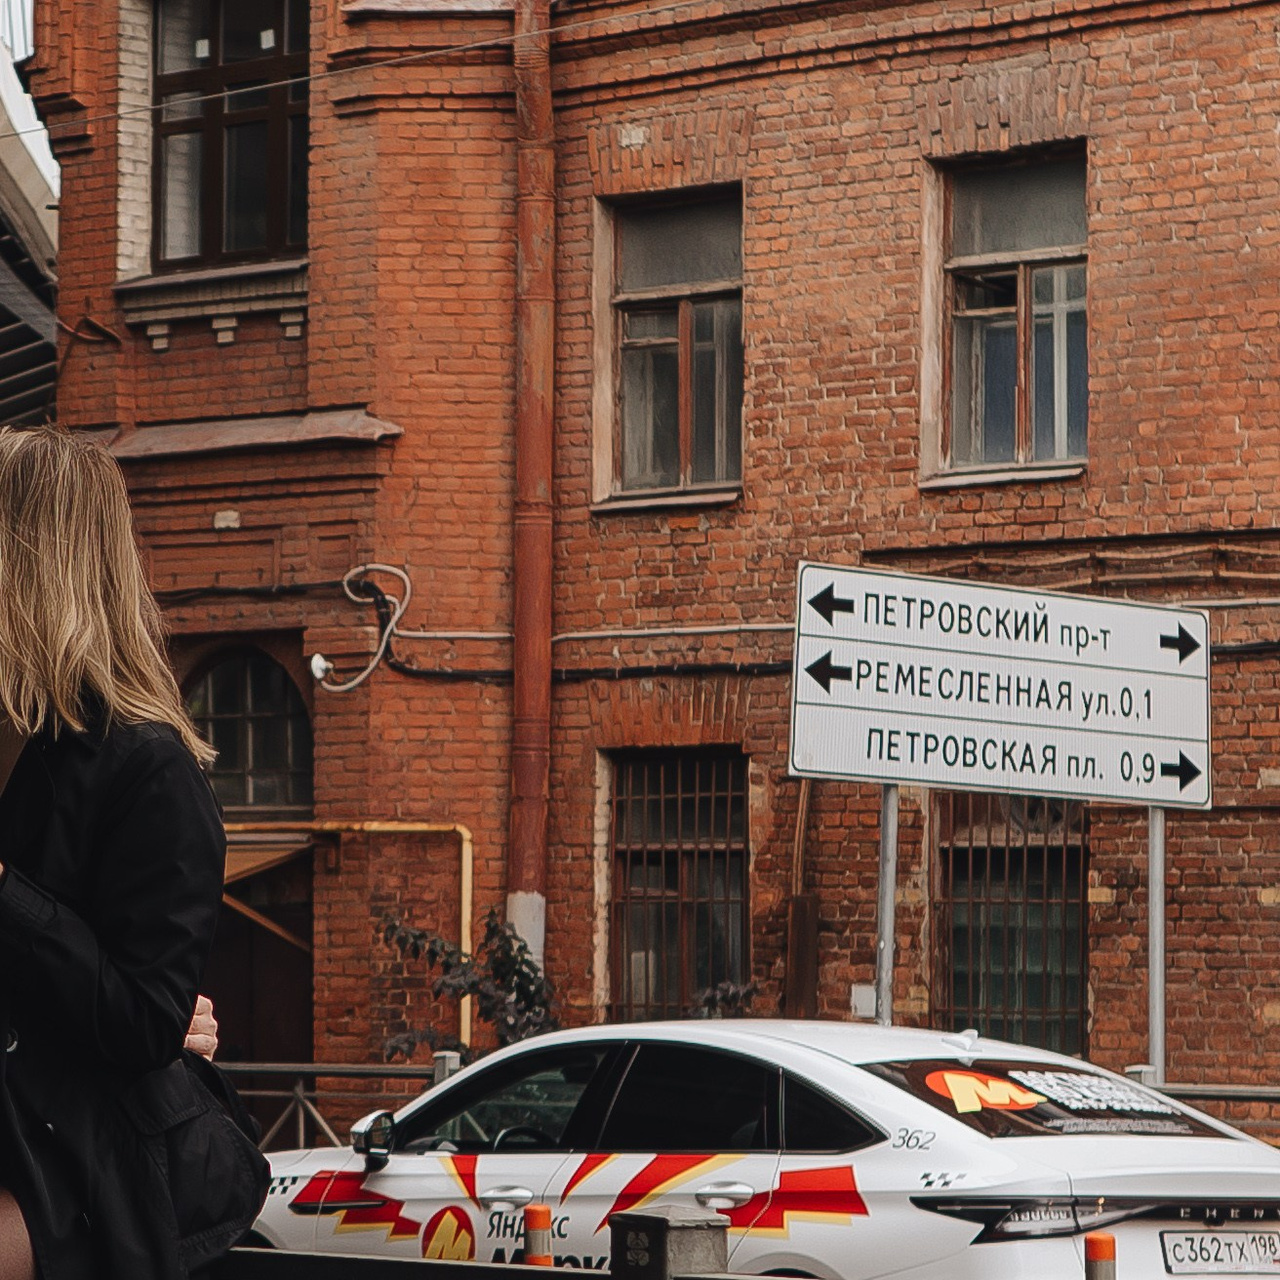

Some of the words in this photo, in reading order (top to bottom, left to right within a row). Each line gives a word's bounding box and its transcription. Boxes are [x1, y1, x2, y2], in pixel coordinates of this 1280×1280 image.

[863, 592, 1049, 644] ПЕТРОВСКИЙ
[1060, 624, 1111, 656] пр-т
[855, 658, 1072, 712] РЕМЕСЛЕННАЯ
[866, 727, 1057, 776] ПЕТРОВСКАЯ
[1067, 754, 1104, 780] пл.
[1120, 750, 1155, 787] 0,9
[892, 1127, 937, 1150] 362
[486, 1211, 570, 1243] Яндкс
[1250, 1235, 1278, 1257] 198
